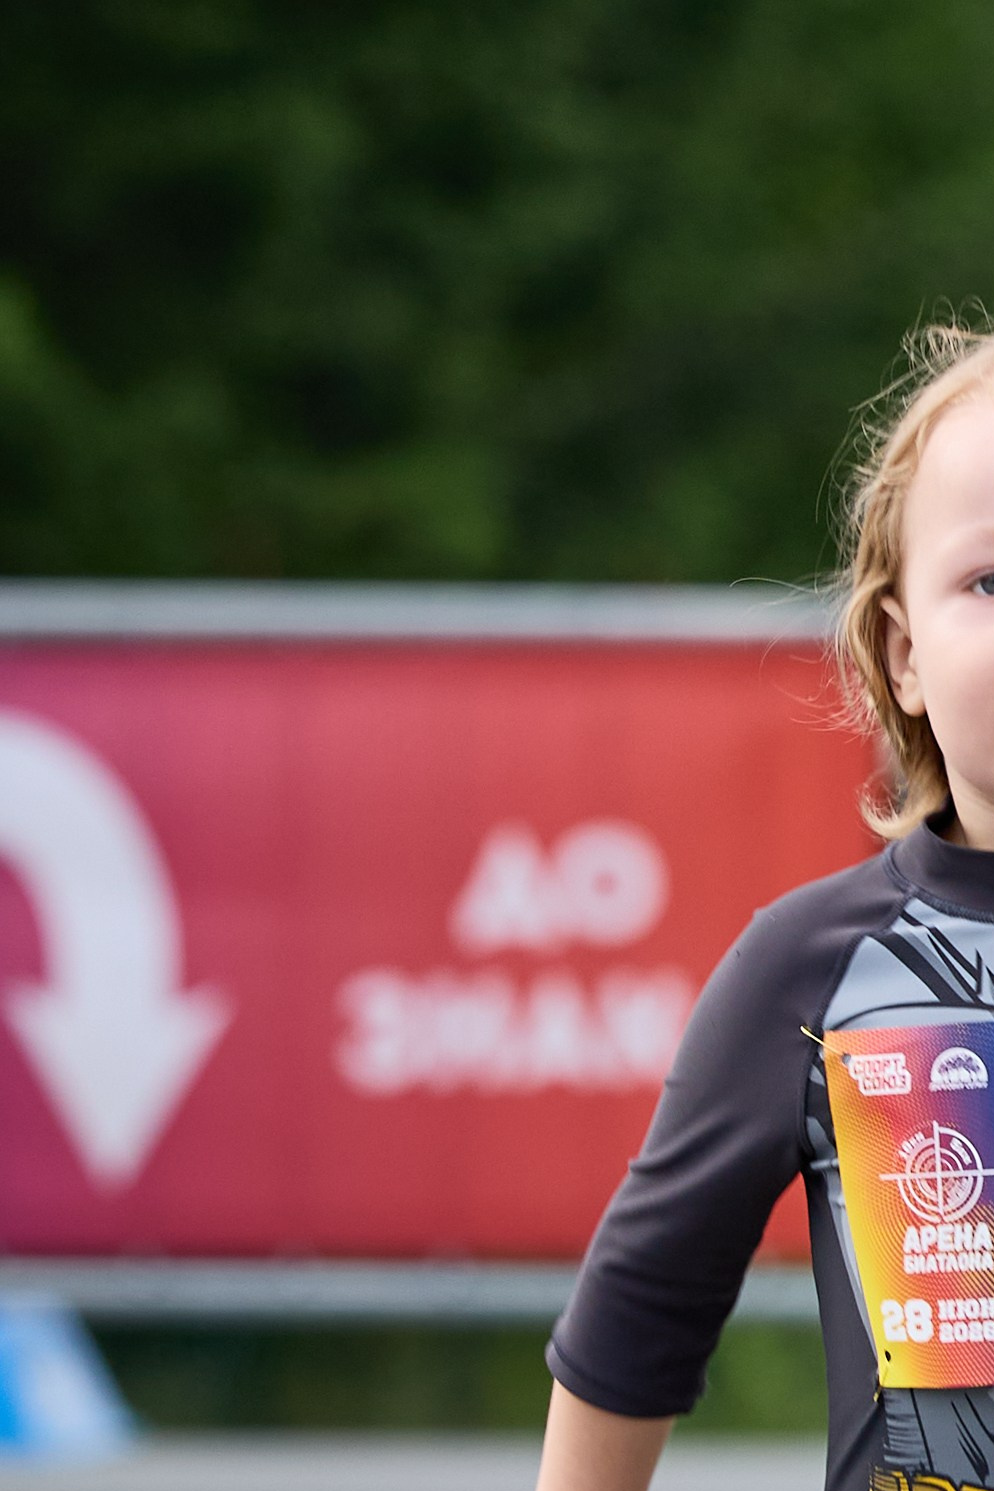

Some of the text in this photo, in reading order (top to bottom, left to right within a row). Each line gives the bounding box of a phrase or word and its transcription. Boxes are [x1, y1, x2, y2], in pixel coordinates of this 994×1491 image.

[447, 821, 671, 955] ДО
[862, 1074, 908, 1091] СОЮЗ
[903, 1221, 994, 1253] АРЕНА
[904, 1250, 994, 1274] БИАТЛОНА
[880, 1298, 934, 1343] 28
